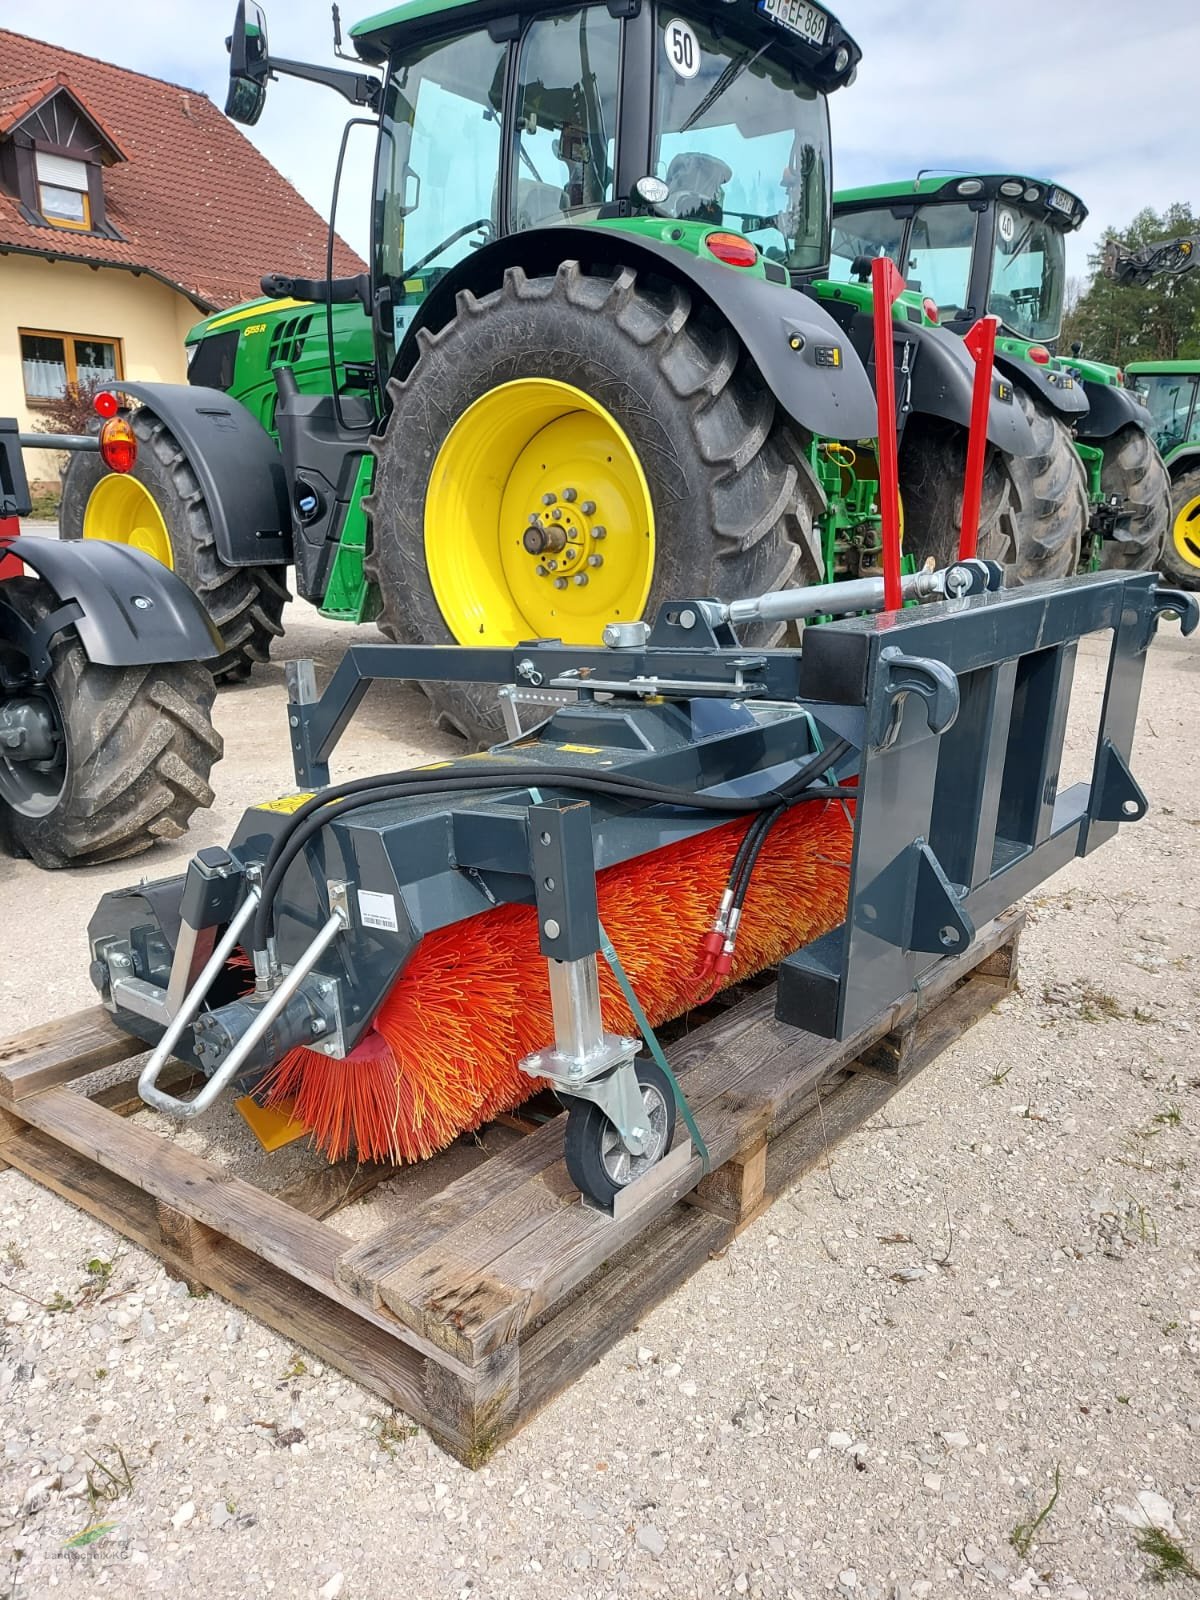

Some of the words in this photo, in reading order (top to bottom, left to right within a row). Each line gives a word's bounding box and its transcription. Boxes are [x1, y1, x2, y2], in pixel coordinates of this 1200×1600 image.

[788, 0, 806, 26] EF
[805, 9, 825, 40] 869
[673, 28, 693, 69] 50
[1002, 215, 1011, 236] 40
[259, 323, 267, 333] R
